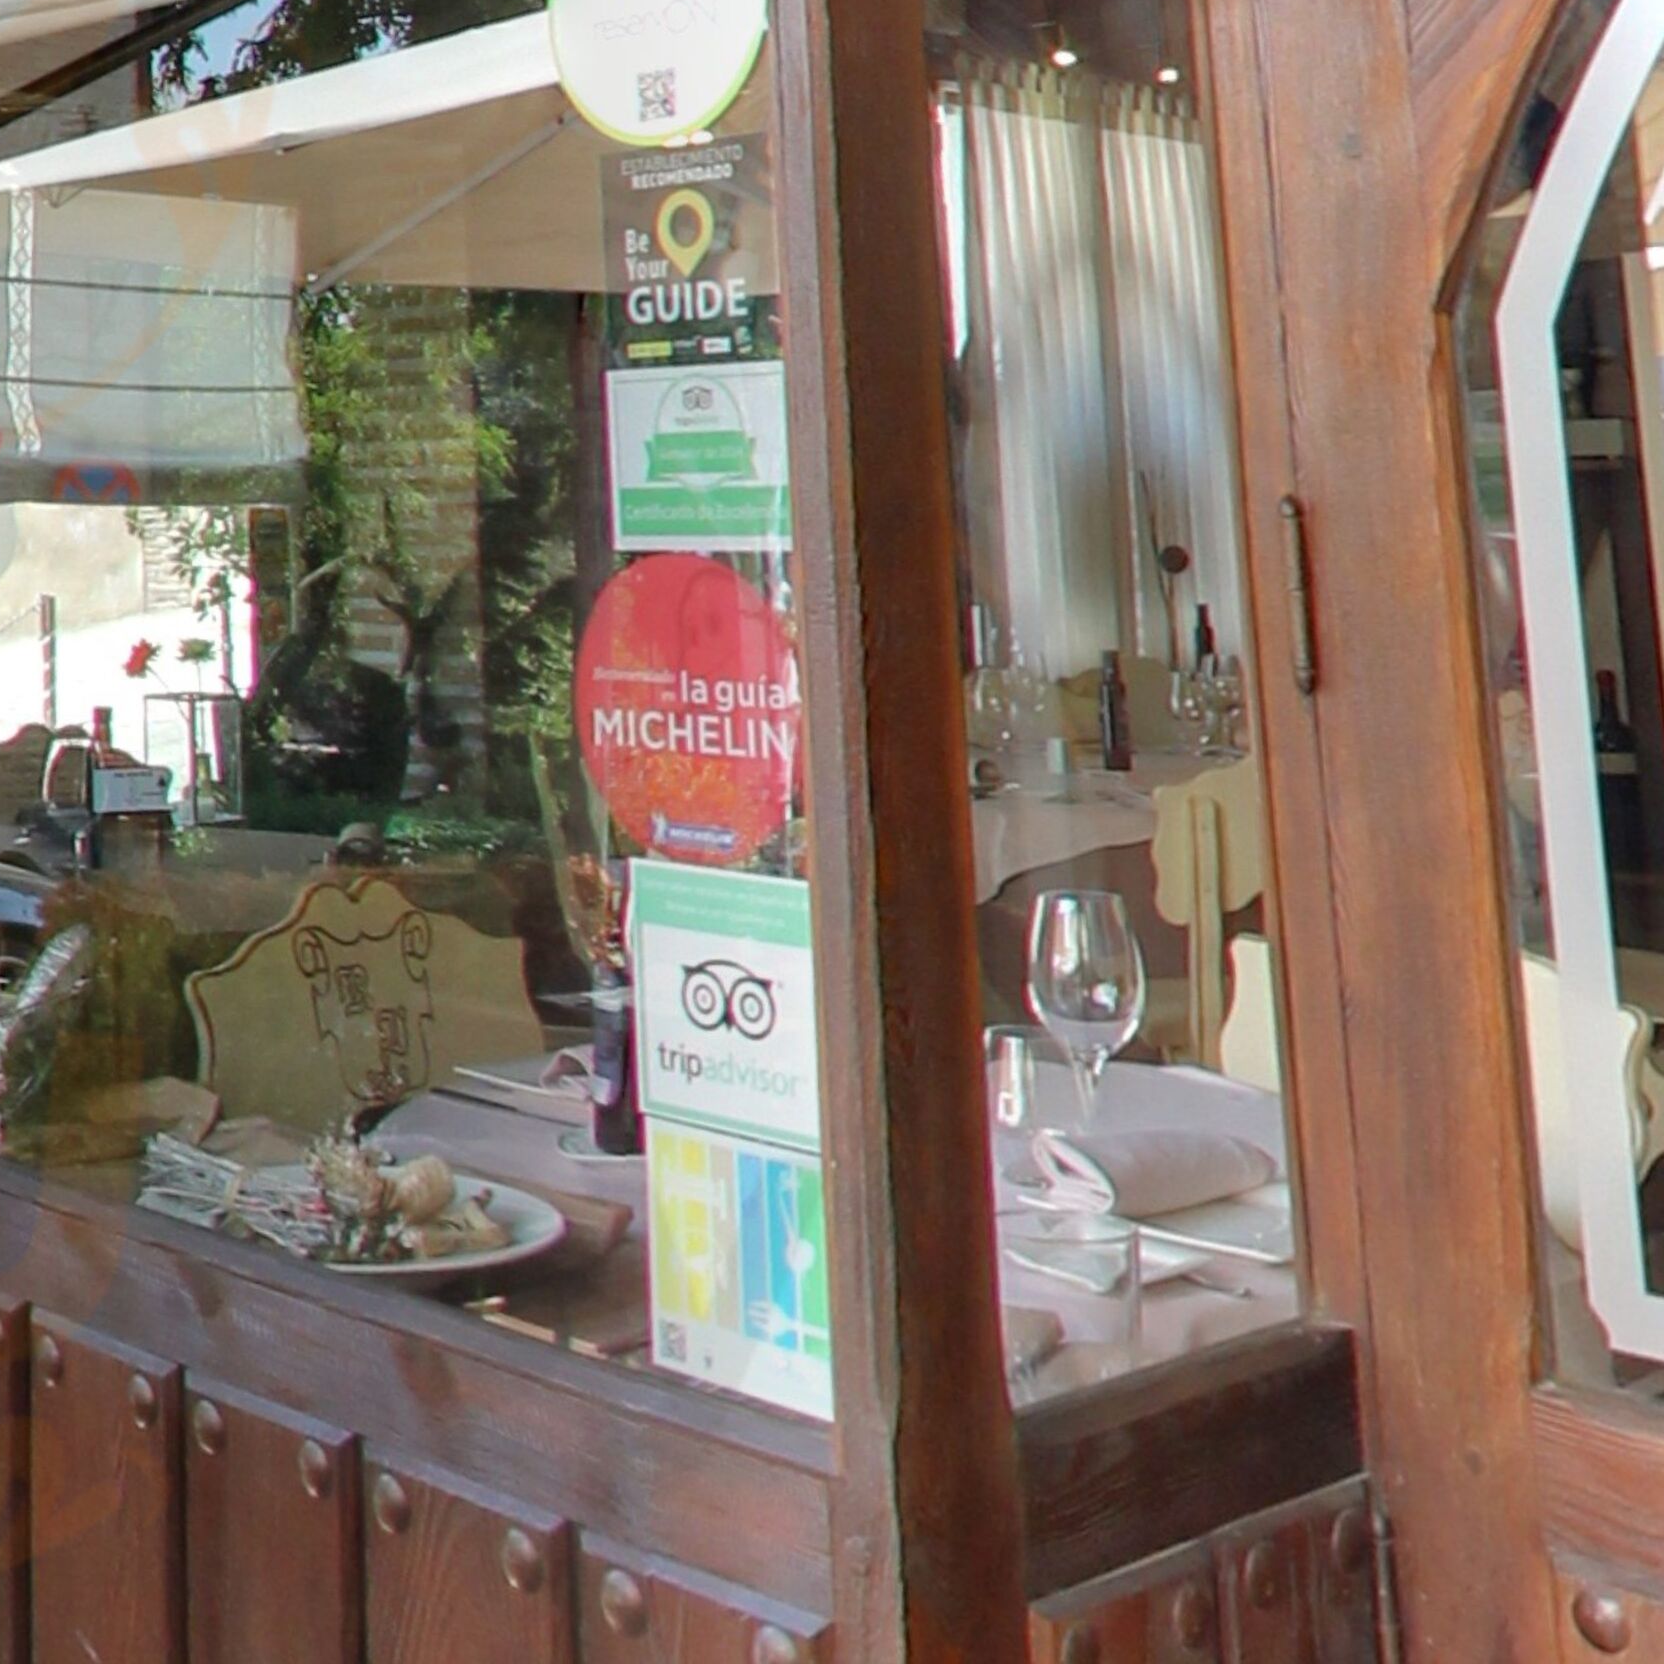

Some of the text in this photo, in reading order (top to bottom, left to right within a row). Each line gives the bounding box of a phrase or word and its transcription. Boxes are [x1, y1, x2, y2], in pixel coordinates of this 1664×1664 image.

[622, 144, 744, 176] ESTABLECIMIENTO
[631, 163, 734, 190] RECOMENDADO
[625, 229, 650, 254] Be
[625, 256, 669, 281] Your
[627, 277, 749, 324] GUIDE
[681, 669, 708, 703] la
[715, 674, 787, 713] guía
[592, 707, 792, 761] MICHELIN
[657, 1042, 802, 1098] tripadvisor
